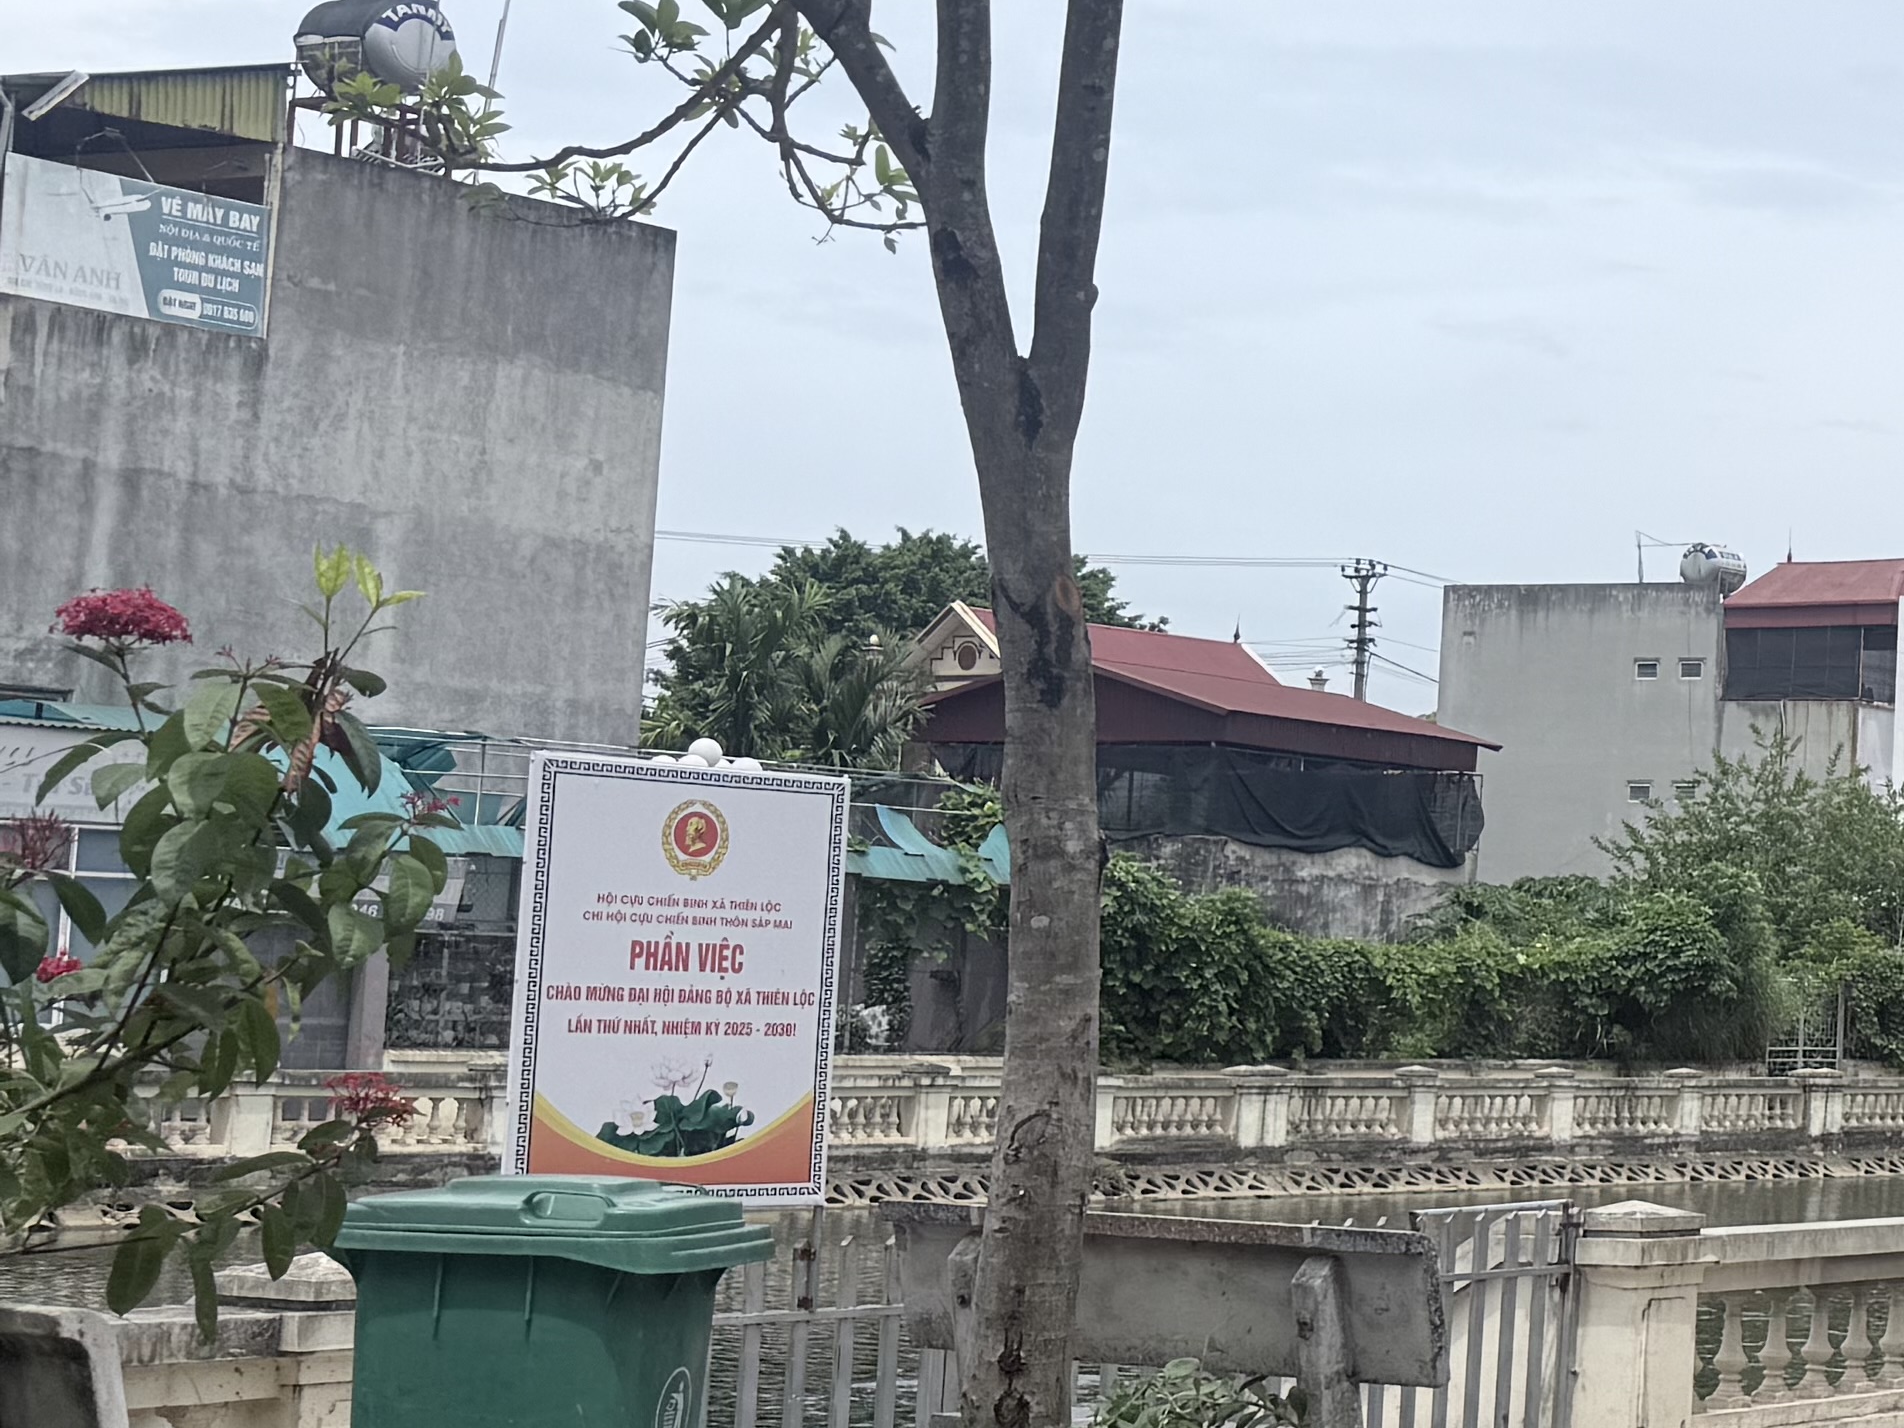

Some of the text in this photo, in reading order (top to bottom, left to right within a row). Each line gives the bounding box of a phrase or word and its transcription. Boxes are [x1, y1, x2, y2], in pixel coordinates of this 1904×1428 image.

[229, 210, 260, 232] BAY
[73, 265, 121, 290] ANH
[173, 267, 240, 293] TOUR DU LỊCH
[597, 891, 617, 907] HỘI
[621, 894, 644, 908] CỰU
[647, 893, 680, 908] CHIẾN
[683, 898, 708, 909] BINH
[730, 898, 757, 911] THIÊN
[761, 900, 782, 915] LỘC
[583, 910, 603, 921] CHI
[606, 909, 627, 924] HỘI
[630, 912, 653, 925] CỰU
[656, 912, 689, 925] CHIẾN
[692, 915, 716, 926] BINH
[720, 915, 748, 928] THÔN
[773, 919, 793, 929] MAI
[629, 930, 745, 980] PHẦN VIỆC
[546, 982, 815, 1009] CHÀO MỪNG ĐẠI HỘI ĐẢNG BỘ XÃ THIÊN LỘC
[596, 1016, 622, 1034] THỨ
[623, 1014, 658, 1036] NHẤT,
[662, 1017, 702, 1039] NHIỆM
[723, 1021, 753, 1036] 2025
[764, 1022, 797, 1037] 2030!
